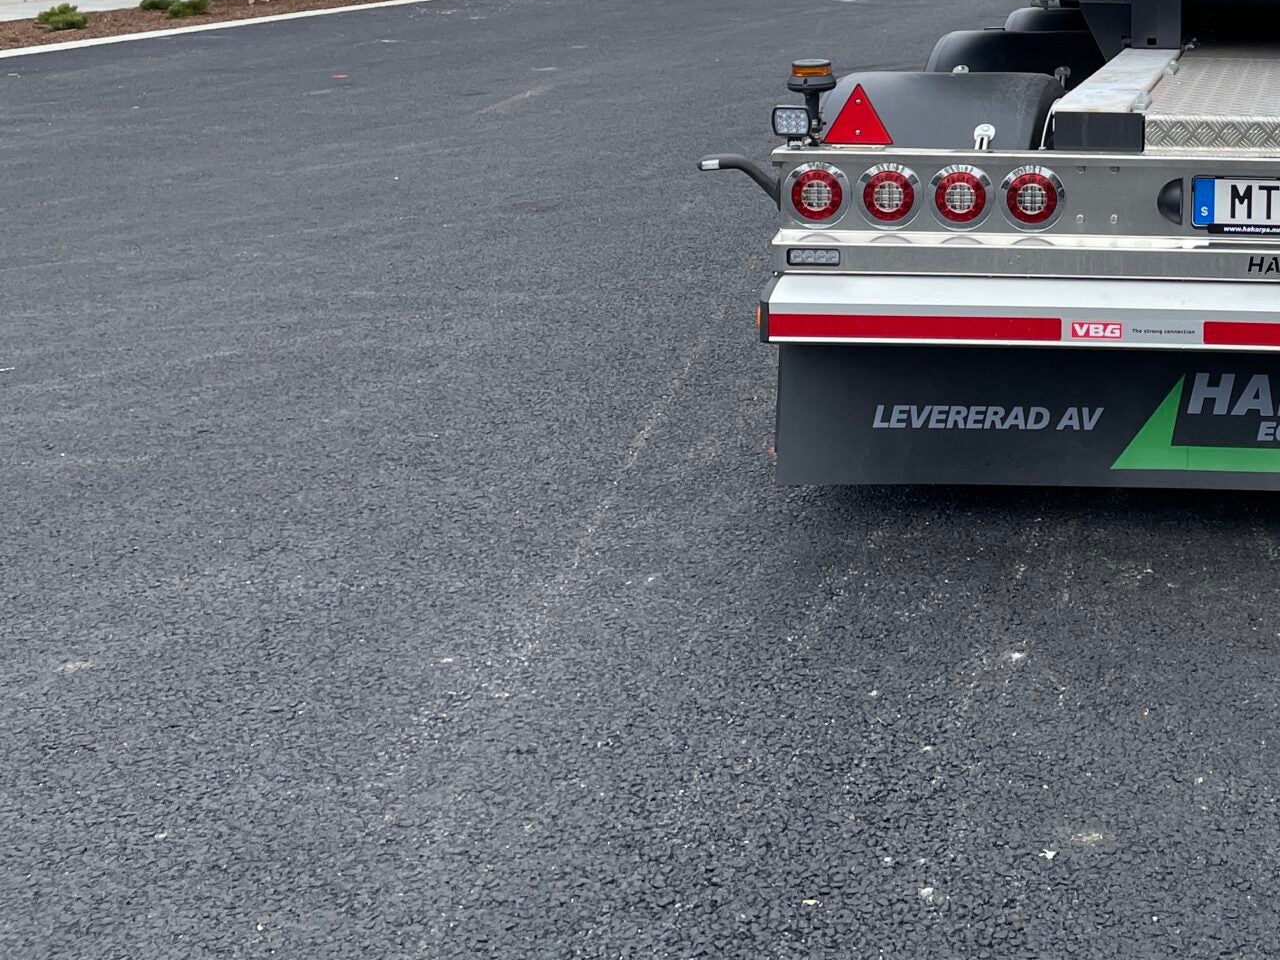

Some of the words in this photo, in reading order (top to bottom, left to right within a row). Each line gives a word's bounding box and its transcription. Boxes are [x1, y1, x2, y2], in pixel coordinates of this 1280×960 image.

[1200, 206, 1209, 217] S
[1223, 225, 1280, 235] www.hakarps.nu
[1073, 323, 1121, 337] VBG
[872, 404, 1051, 430] LEVERERAD
[1056, 406, 1104, 431] AV
